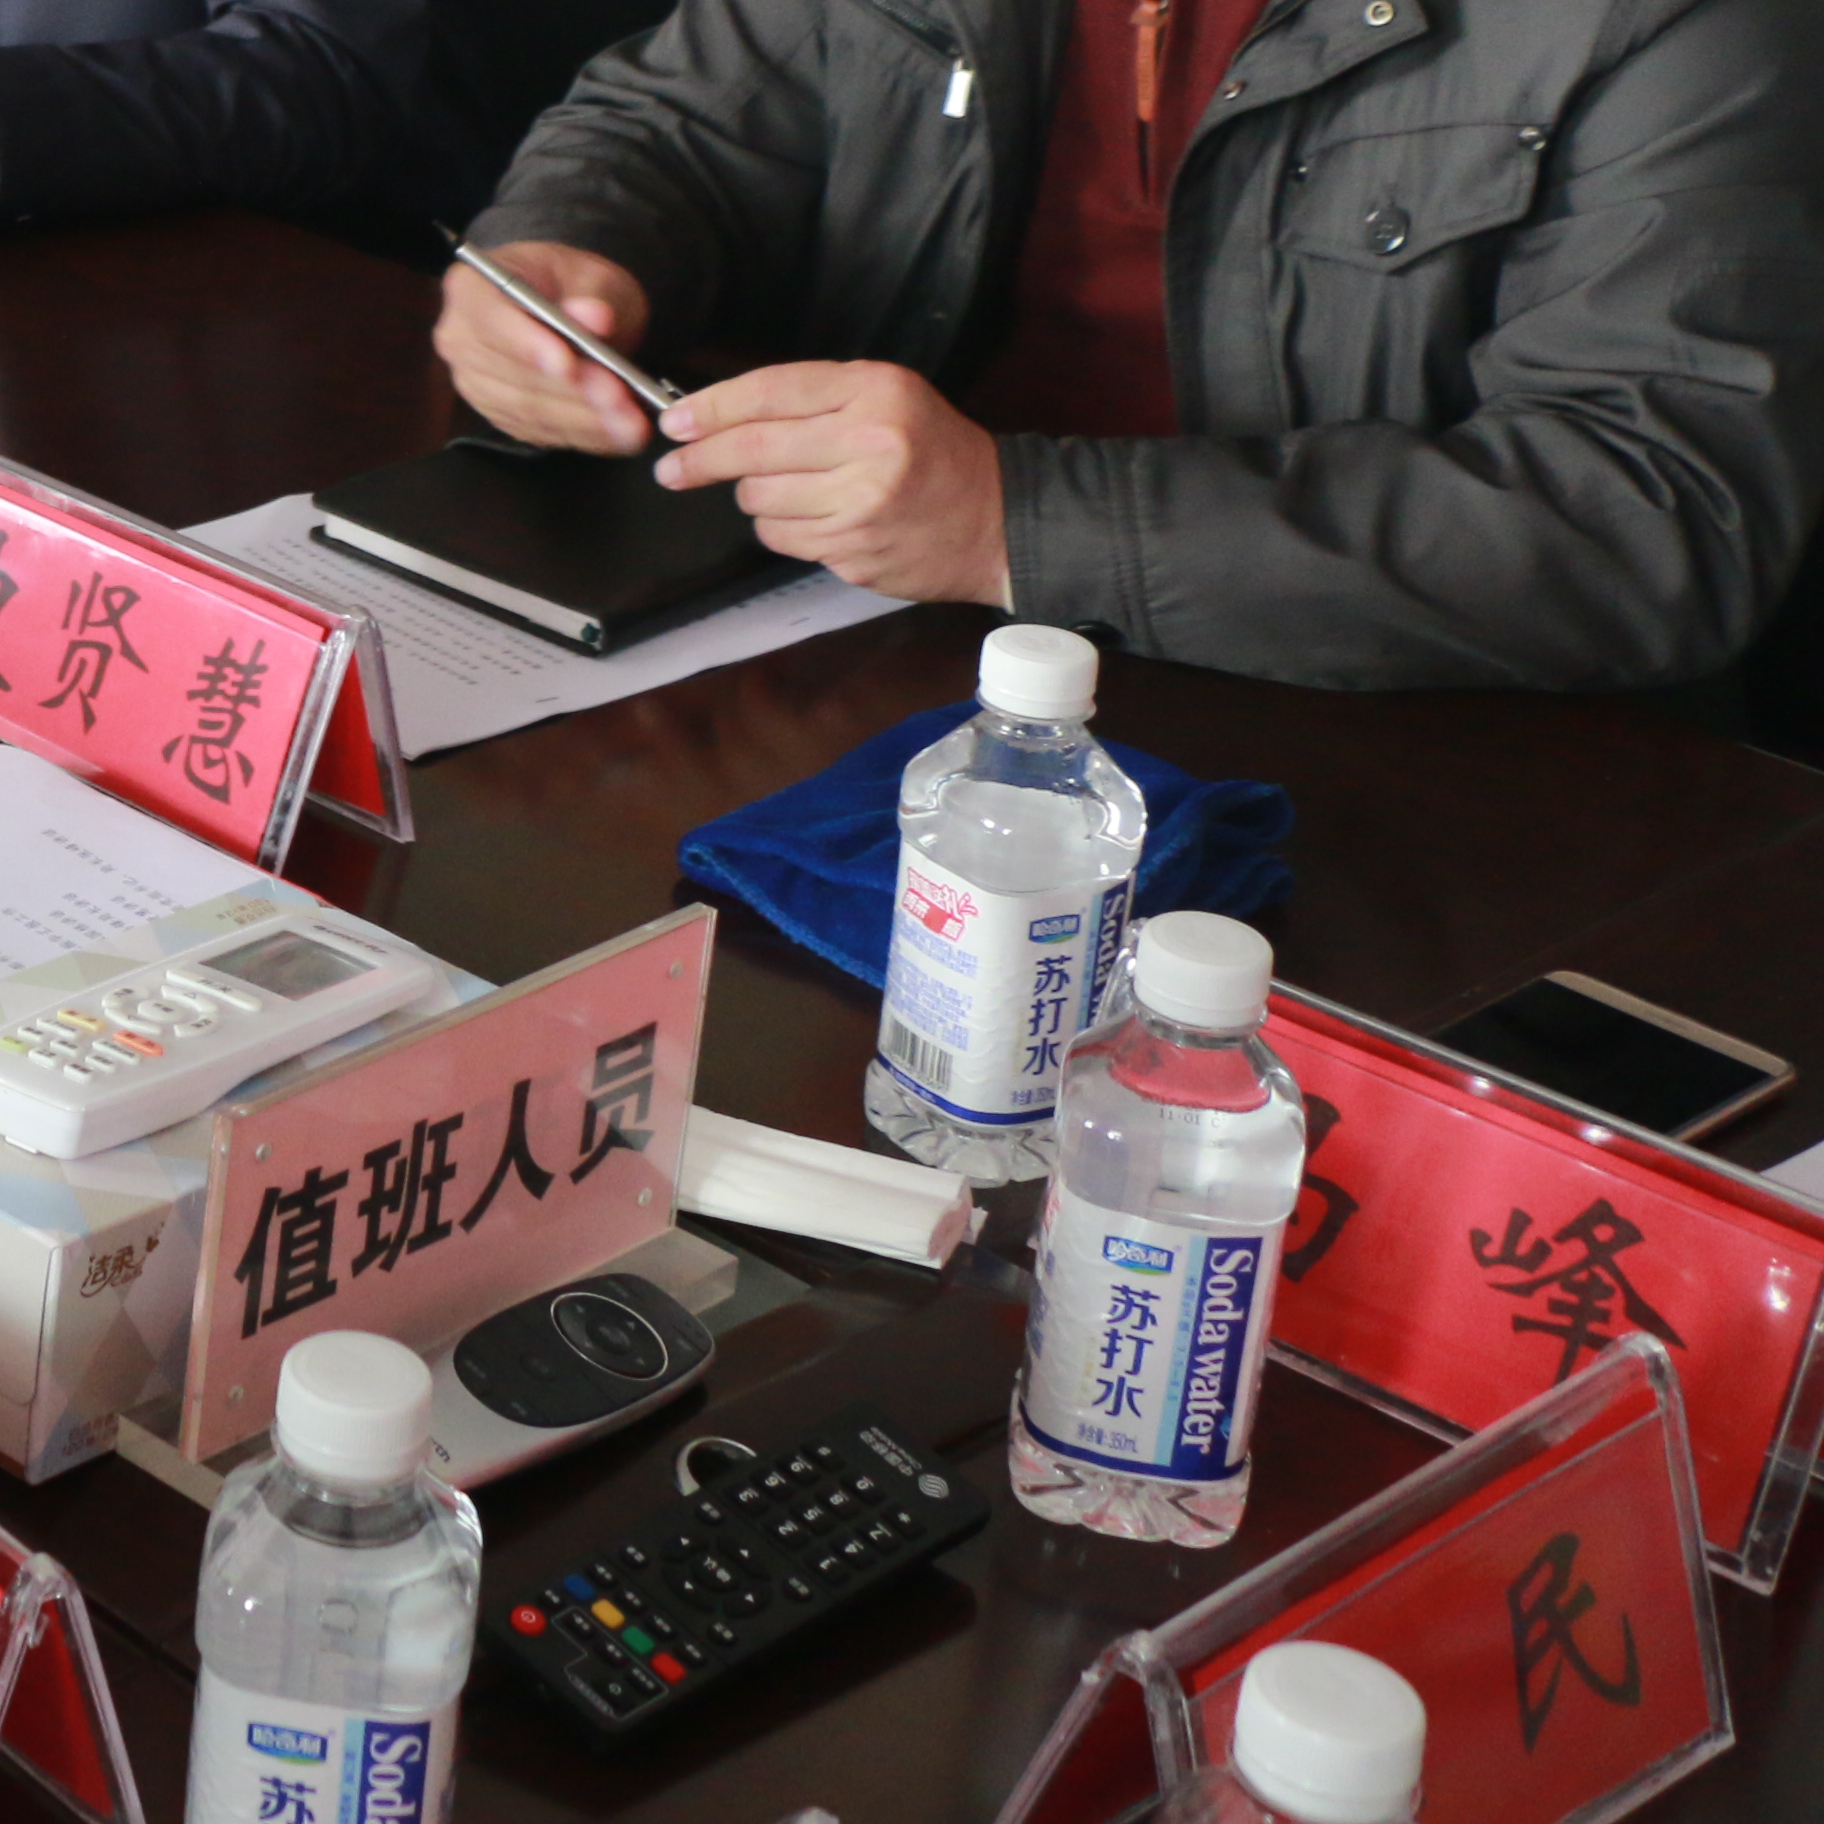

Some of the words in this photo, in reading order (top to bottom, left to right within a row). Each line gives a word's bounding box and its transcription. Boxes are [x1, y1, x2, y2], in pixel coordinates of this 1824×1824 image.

[1025, 956, 1073, 1075] 苏打水
[233, 1020, 658, 1341] 值班人员
[1091, 1284, 1160, 1419] 苏打水
[1197, 1247, 1254, 1344] Soda
[1180, 1348, 1227, 1455] water
[1506, 1530, 1642, 1754] 民
[365, 1732, 425, 1824] Sod
